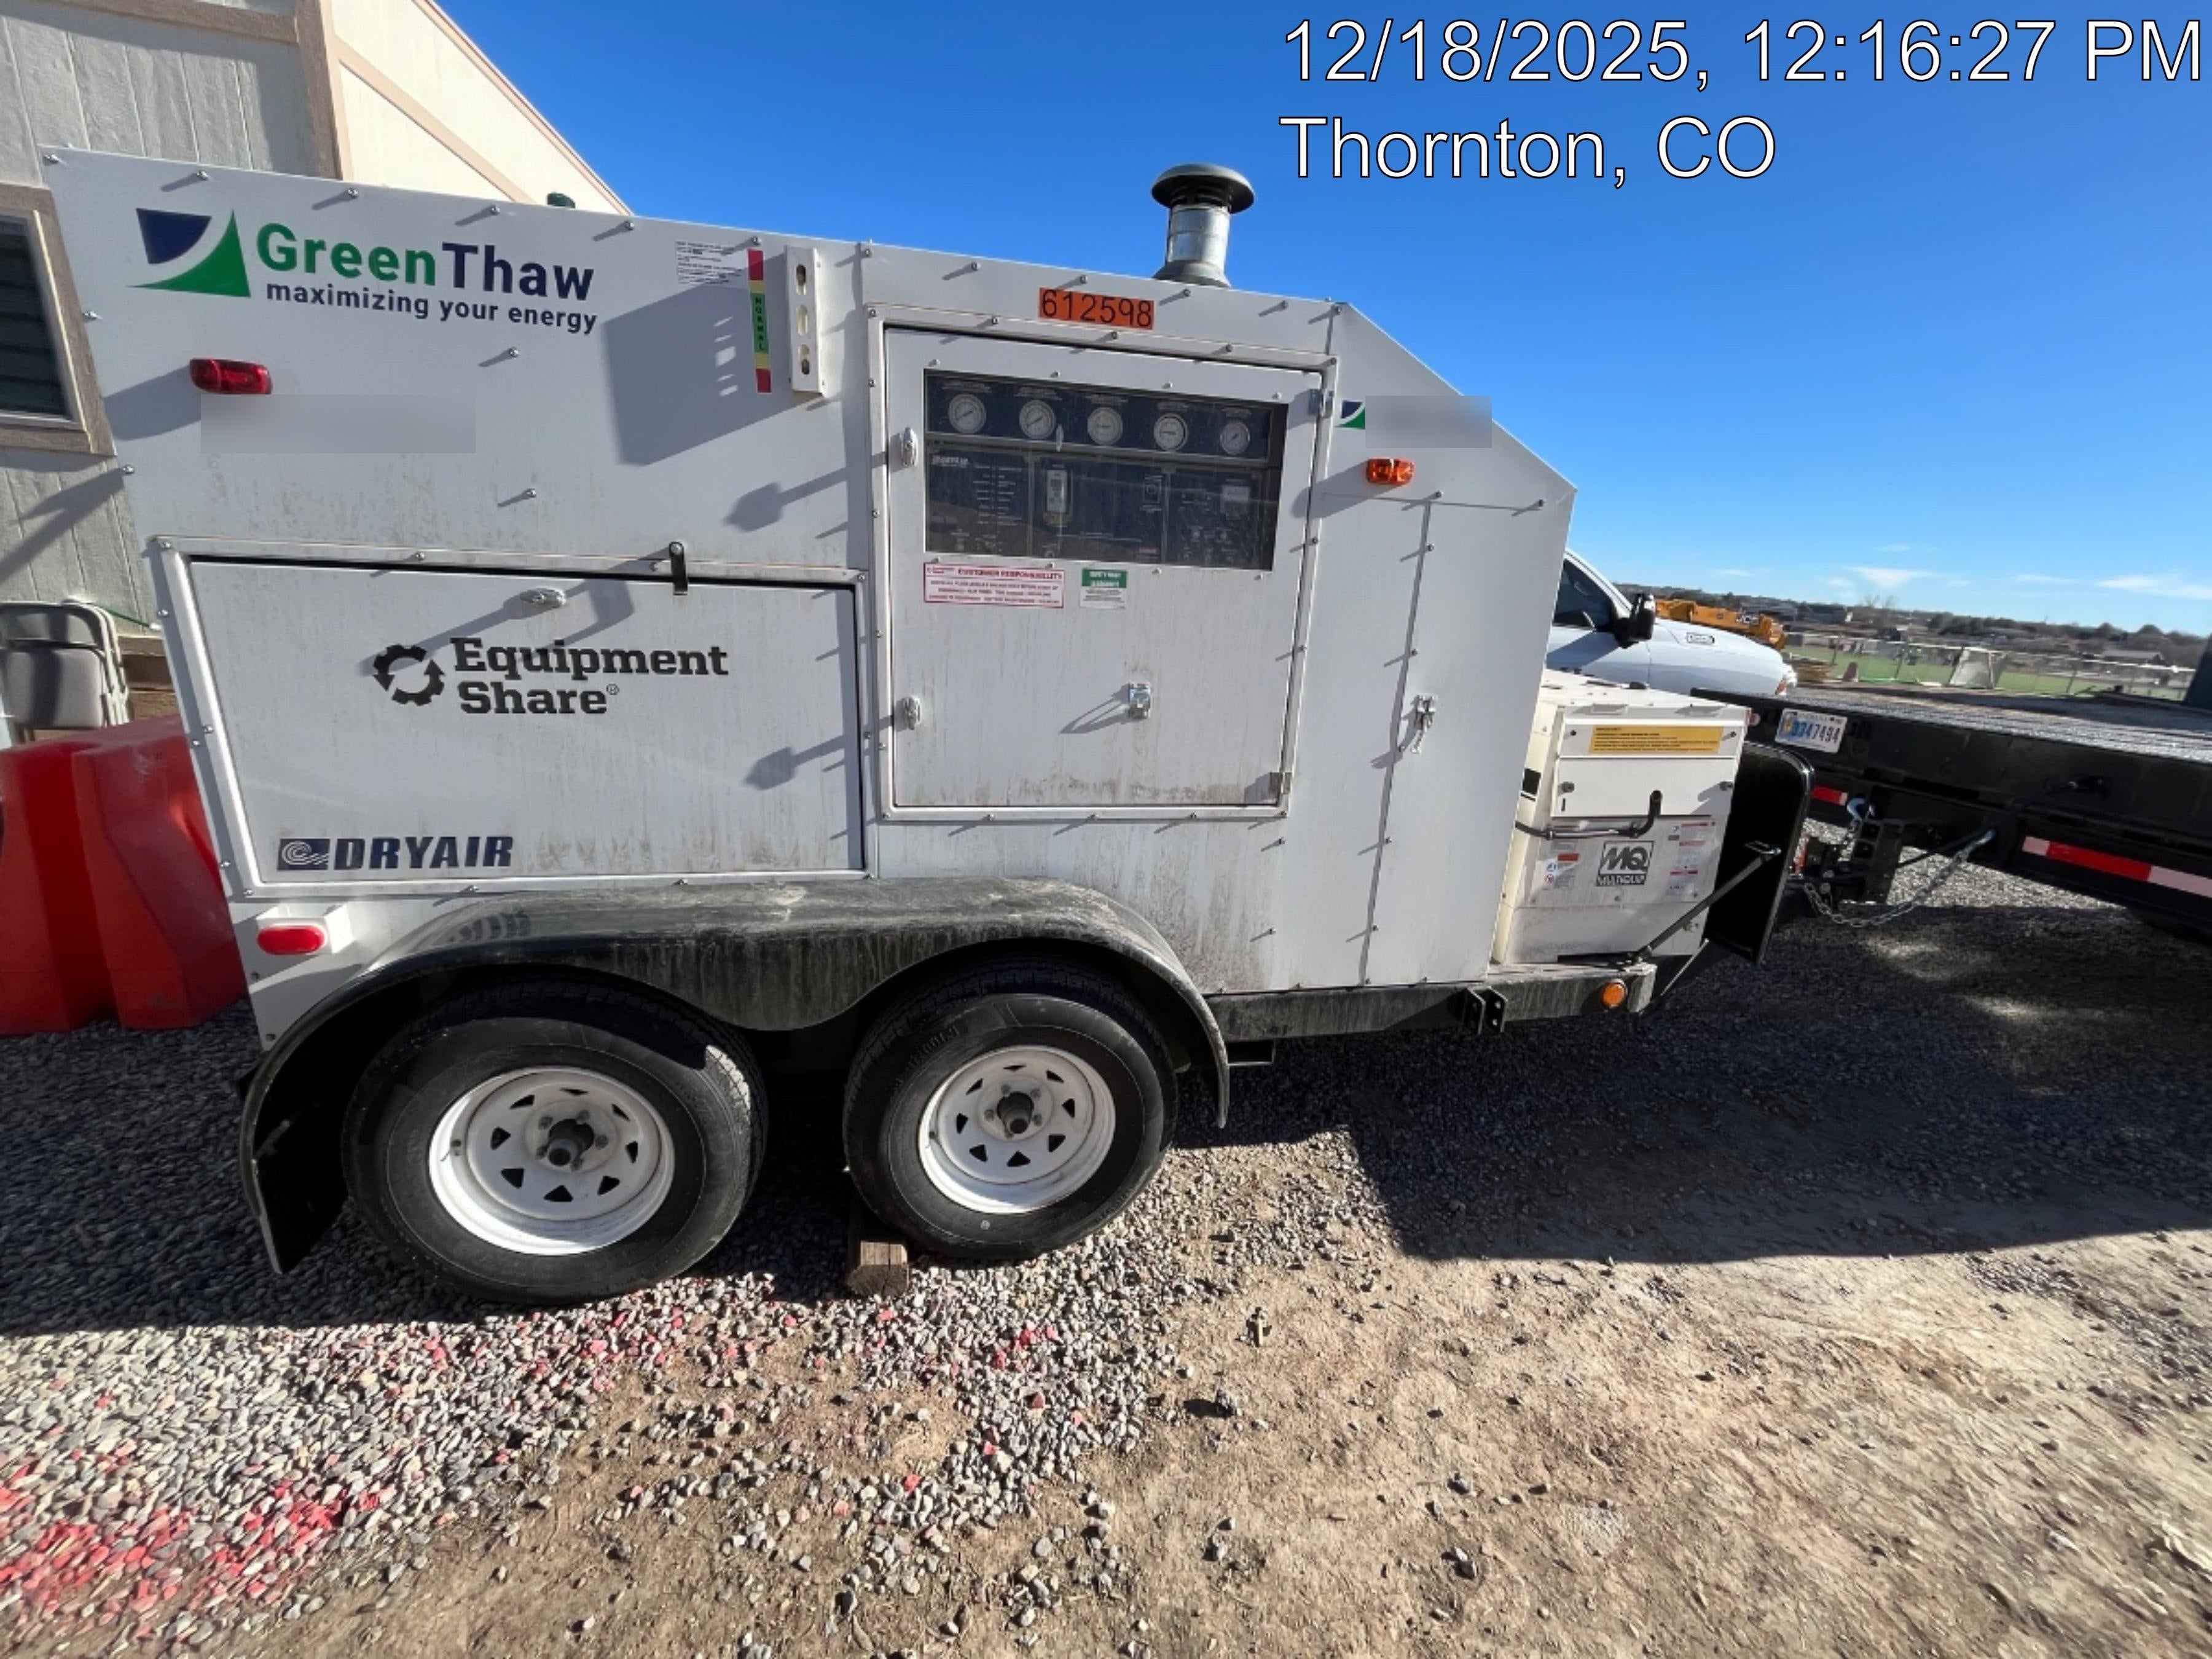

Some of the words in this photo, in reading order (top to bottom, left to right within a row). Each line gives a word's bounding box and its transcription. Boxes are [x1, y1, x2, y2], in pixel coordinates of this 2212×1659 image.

[256, 222, 594, 301] GreenThaw
[266, 281, 429, 319] maximizing
[439, 299, 498, 321] your
[508, 306, 597, 335] energy
[1042, 289, 1152, 327] 612598
[450, 637, 729, 681] Equipment
[333, 836, 514, 870] DRYAIR
[1600, 845, 1648, 872] MQ
